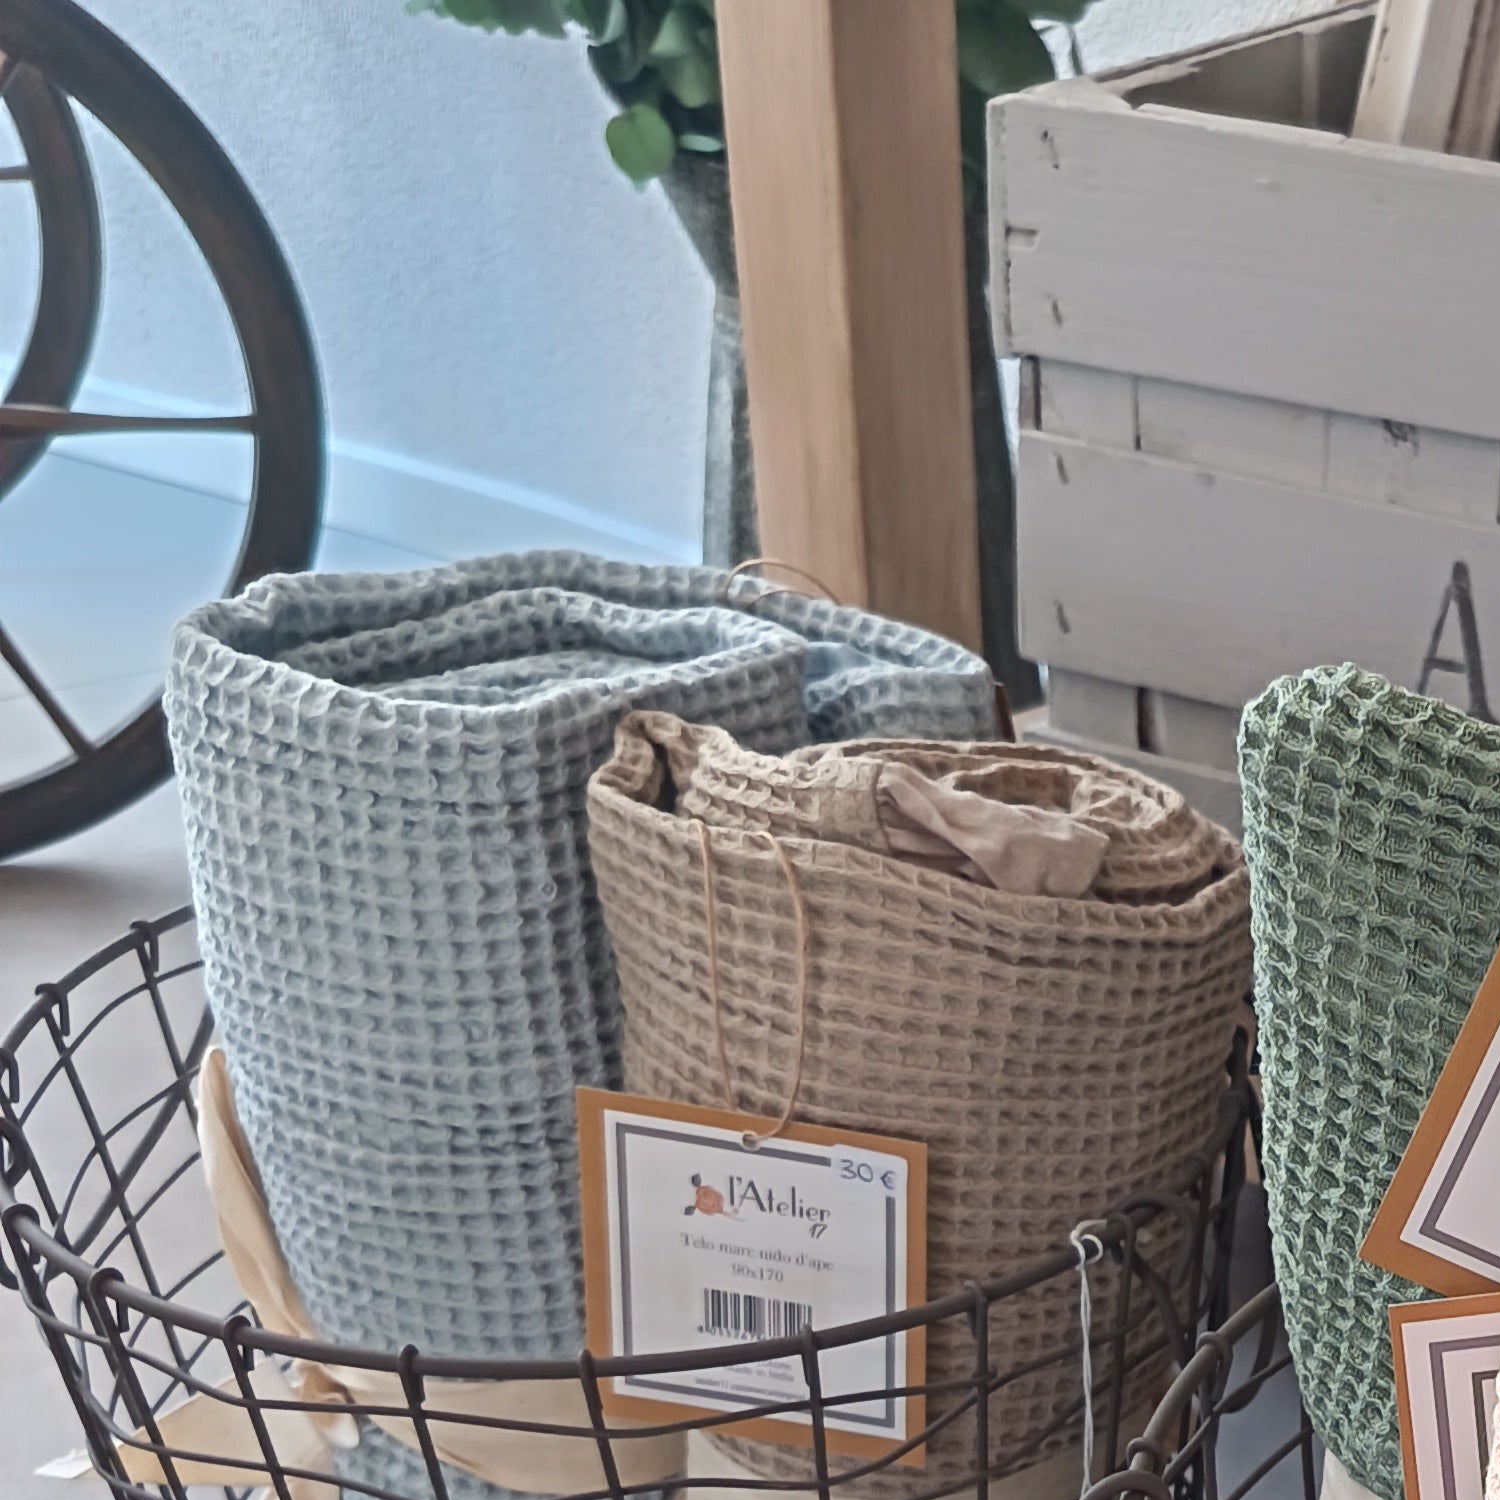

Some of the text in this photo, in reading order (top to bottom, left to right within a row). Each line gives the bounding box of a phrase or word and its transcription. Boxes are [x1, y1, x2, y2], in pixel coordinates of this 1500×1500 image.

[729, 1175, 831, 1222] l'Atelier
[810, 1223, 828, 1239] 17
[680, 1231, 715, 1251] Telo
[719, 1241, 755, 1258] mare
[759, 1248, 791, 1264] nido
[732, 1262, 784, 1283] 90x170
